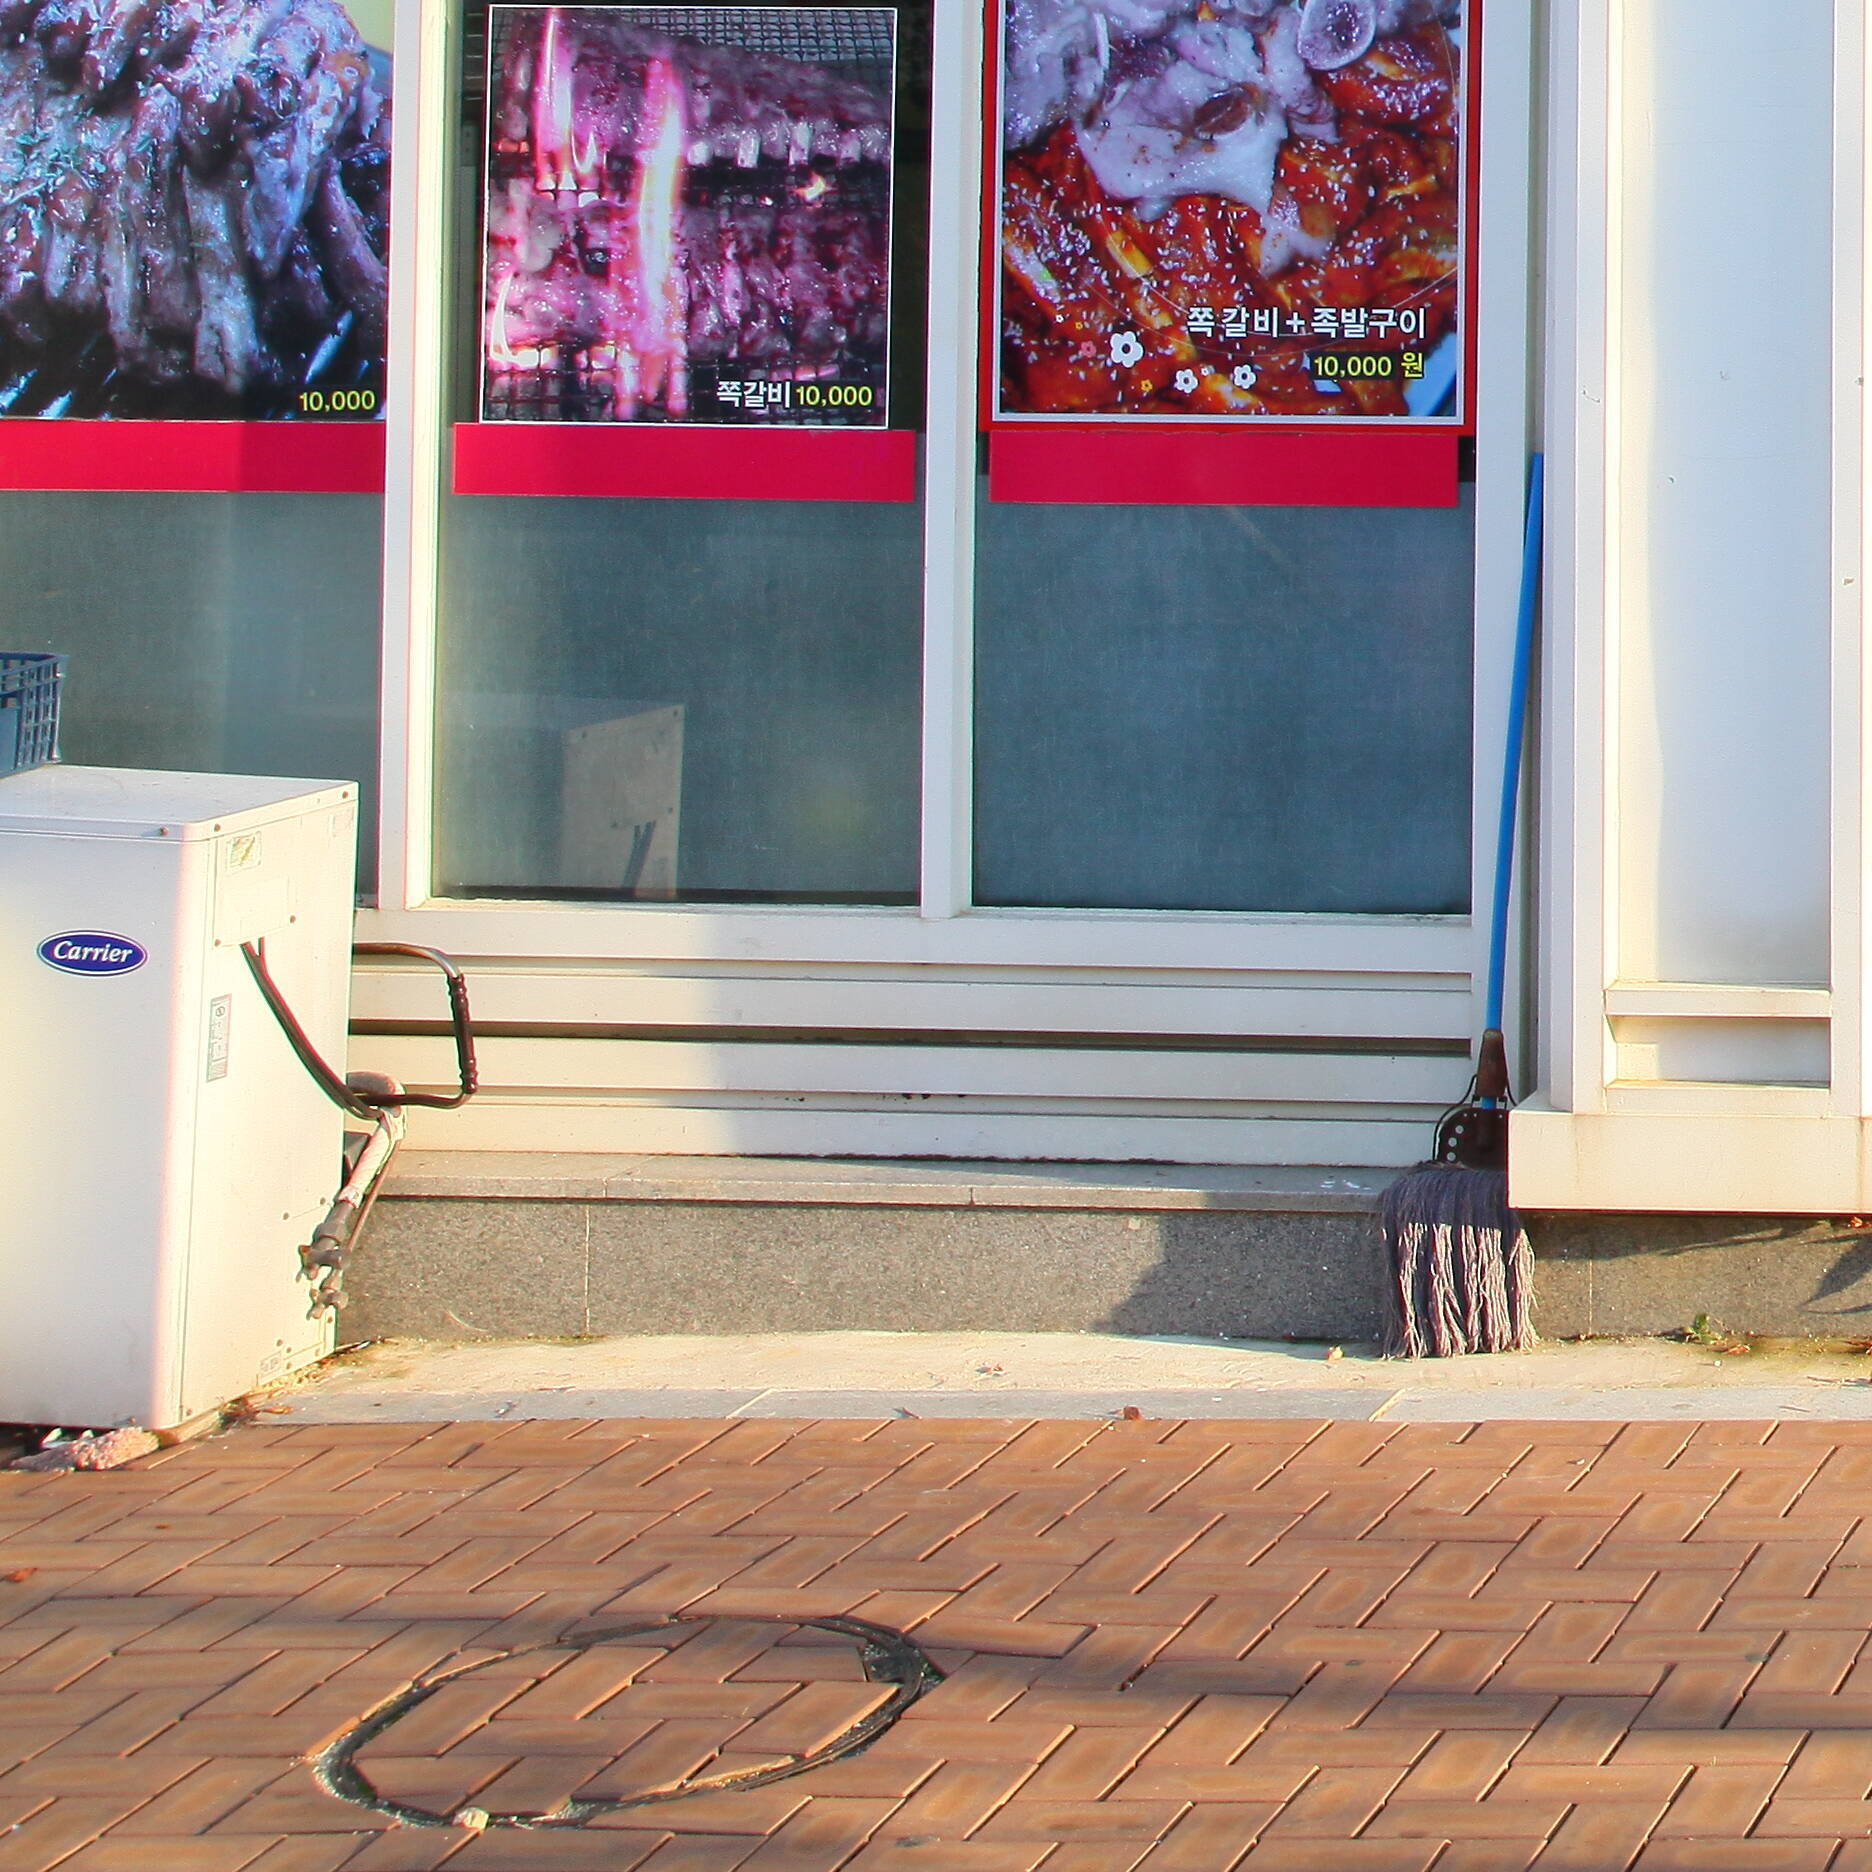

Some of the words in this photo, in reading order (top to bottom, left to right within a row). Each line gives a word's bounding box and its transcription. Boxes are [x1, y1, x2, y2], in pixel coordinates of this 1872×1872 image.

[1314, 355, 1393, 378] 10,000
[1400, 351, 1425, 379] 원
[299, 389, 376, 413] 10,000
[716, 380, 791, 409] 쪽갈비
[795, 385, 874, 408] 10,000
[53, 939, 134, 964] Carrier
